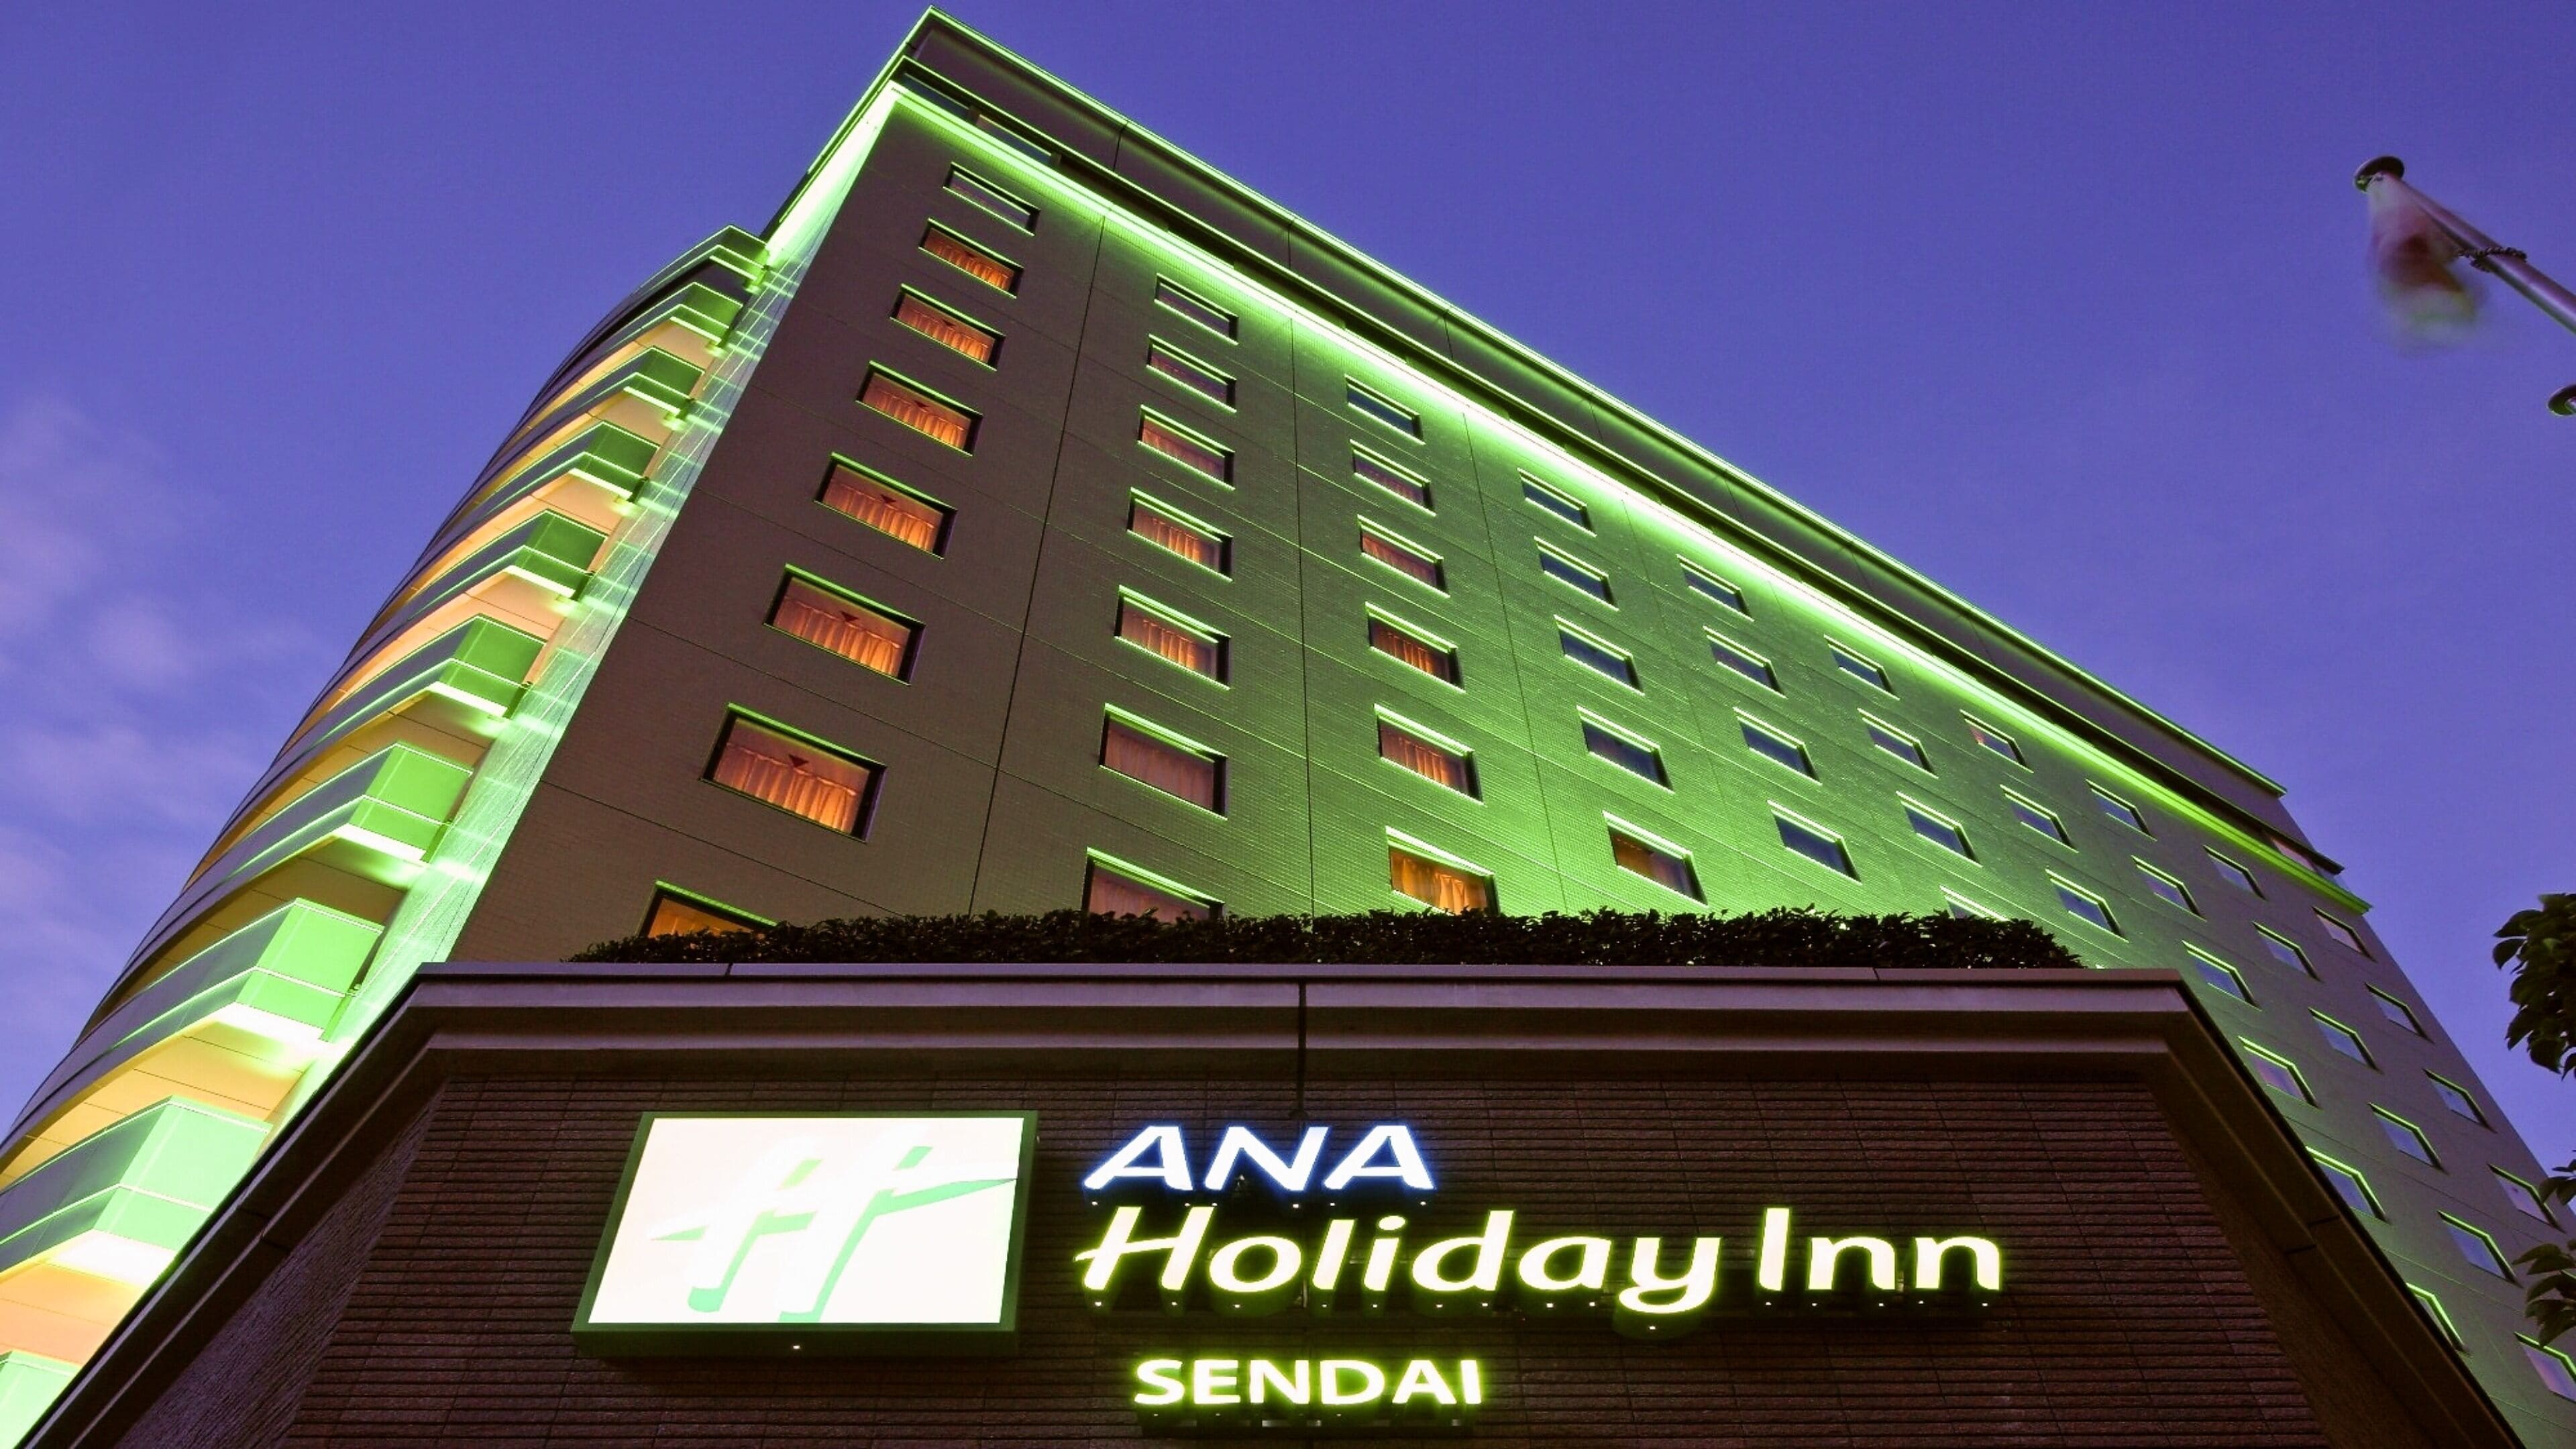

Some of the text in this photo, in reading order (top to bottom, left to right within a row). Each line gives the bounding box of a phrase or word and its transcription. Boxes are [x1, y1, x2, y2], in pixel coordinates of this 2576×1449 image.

[1083, 1124, 1435, 1192] ANA
[1075, 1206, 2001, 1315] Holiday Inn
[1133, 1357, 1485, 1407] SENDAI
